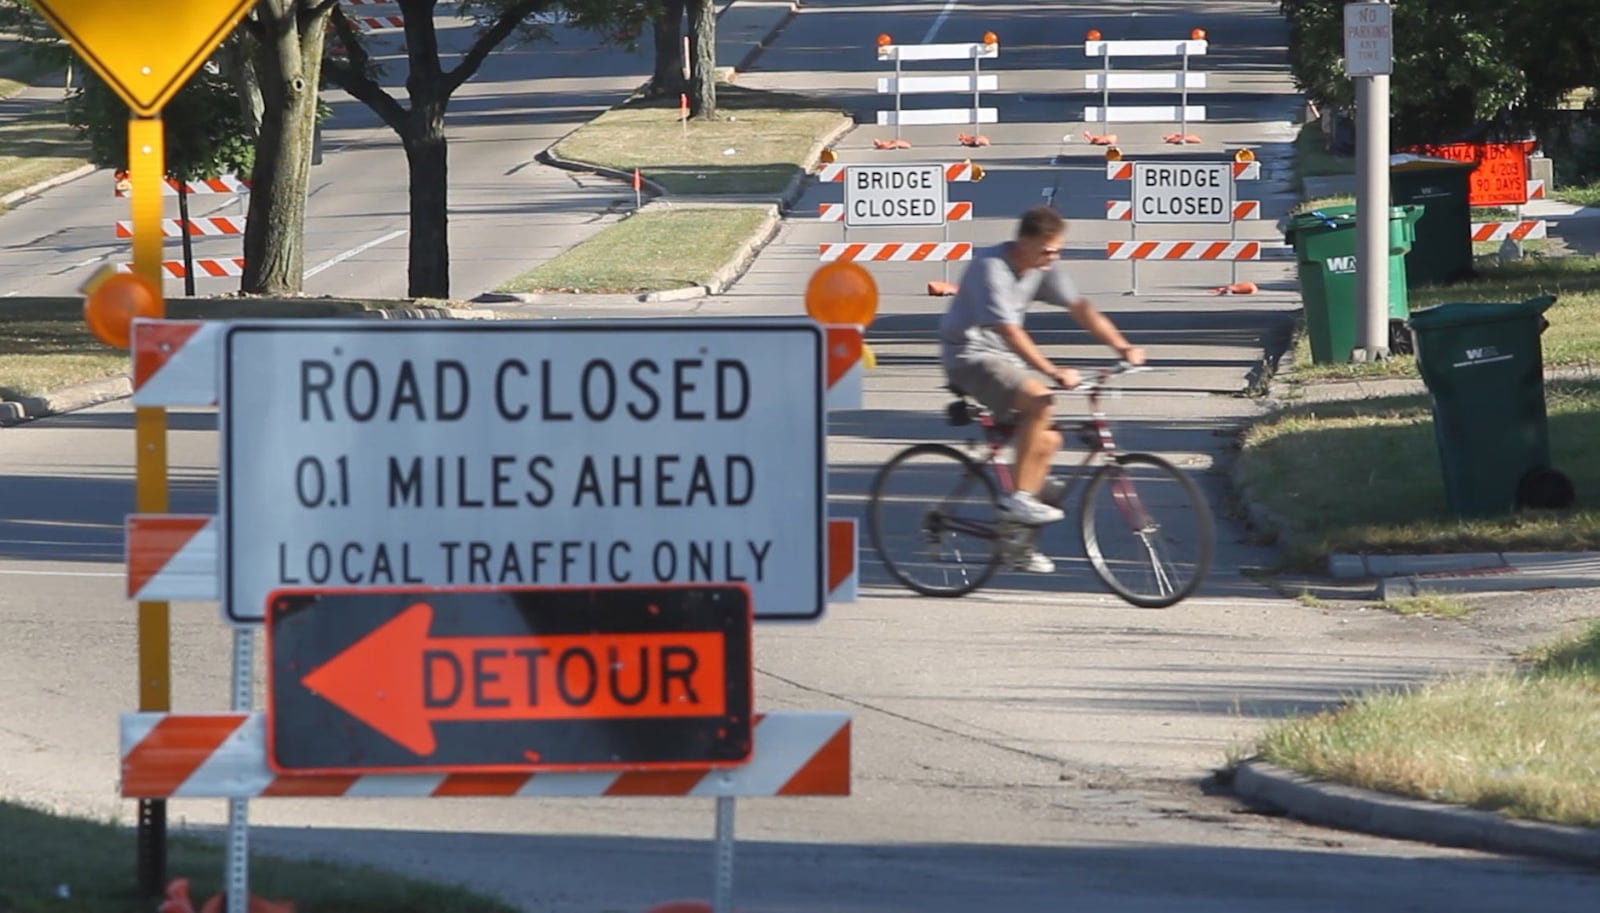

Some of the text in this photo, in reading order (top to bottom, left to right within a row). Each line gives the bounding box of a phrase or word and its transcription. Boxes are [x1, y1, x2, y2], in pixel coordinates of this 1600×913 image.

[1359, 8, 1377, 23] NO
[1349, 24, 1390, 39] PARKING
[856, 171, 933, 190] BRIDGE
[1144, 168, 1221, 188] BRIDGE
[1495, 177, 1521, 191] DAYS
[854, 198, 936, 218] CLOSED
[1141, 196, 1224, 216] CLOSED
[301, 356, 752, 423] ROAD CLOSED
[295, 453, 756, 509] 0.1 MILES AHEAD
[278, 539, 774, 585] LOCAL TRAFFIC ONLY
[422, 646, 700, 708] DETOUR
